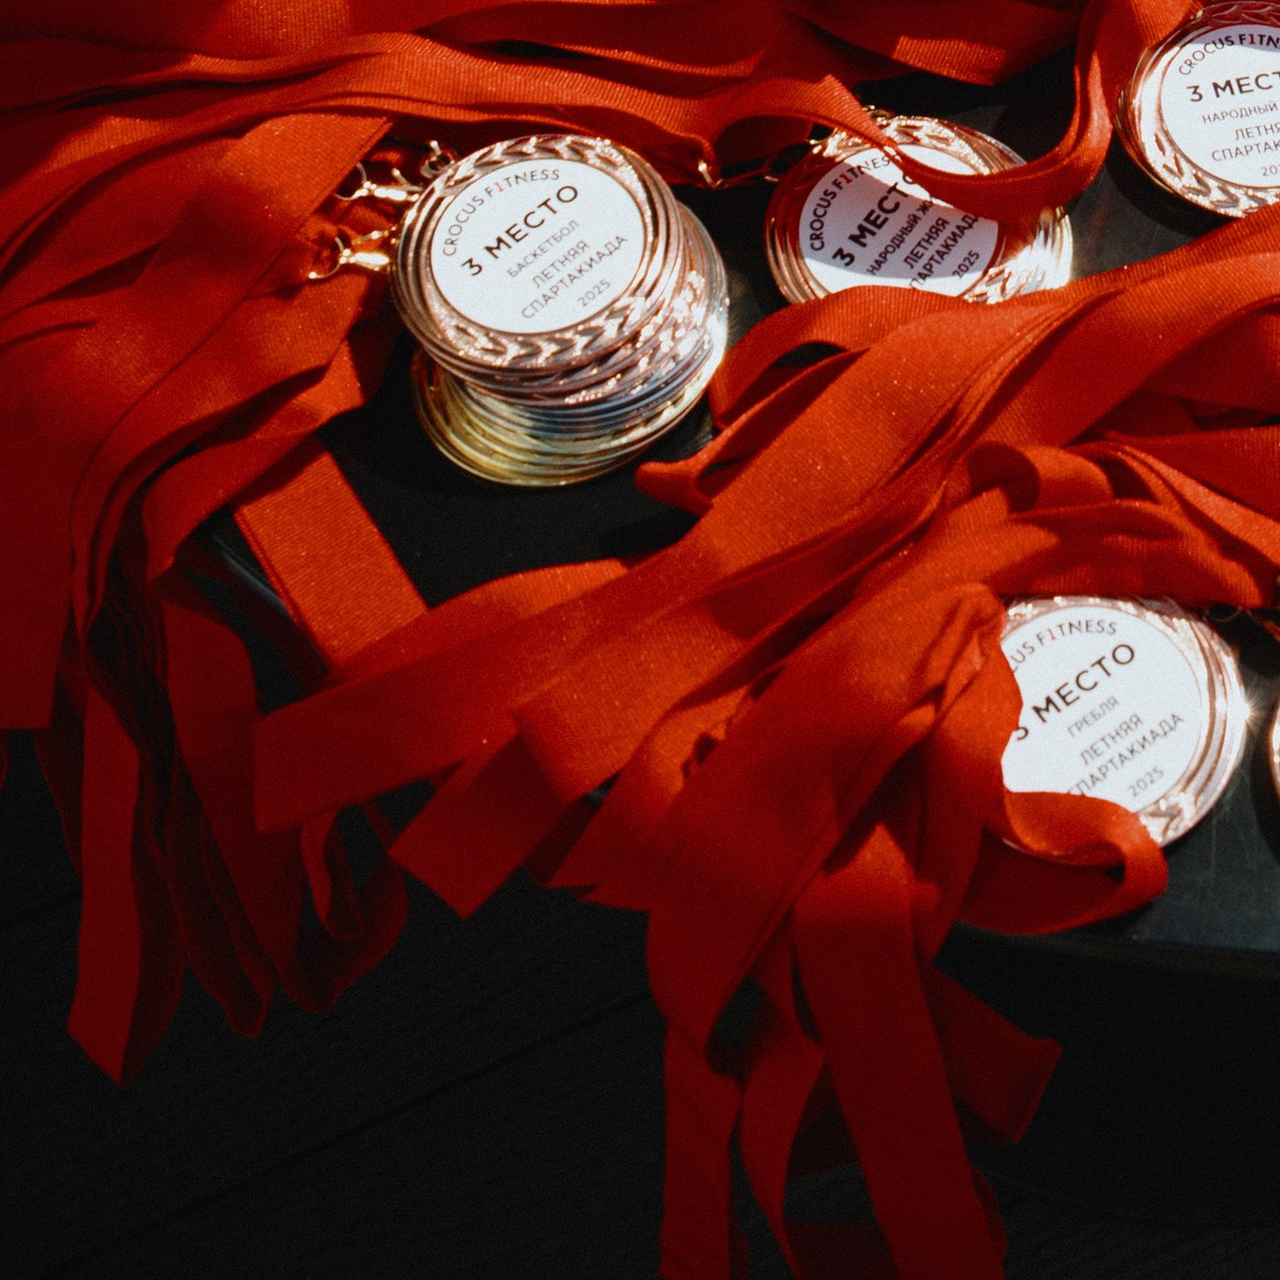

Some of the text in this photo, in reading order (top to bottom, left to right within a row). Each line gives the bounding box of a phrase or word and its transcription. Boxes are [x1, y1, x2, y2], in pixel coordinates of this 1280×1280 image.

[1178, 35, 1235, 75] CROCUS
[1187, 85, 1203, 102] 3
[1202, 101, 1278, 124] НАРОДНЫЙ
[443, 196, 484, 257] CROCUS
[461, 185, 578, 276] 3 МЕСТО
[810, 189, 838, 251] CROCUS
[866, 214, 921, 275] НАРОДНЫЙ
[903, 217, 950, 269] ЛЕТНЯЯ
[507, 220, 580, 278] БАСКЕТБОЛ
[532, 240, 590, 288] ЛЕТНЯЯ
[832, 248, 855, 267] 3
[952, 250, 980, 279] 2025
[522, 235, 628, 319] СПАРТАКИАДА
[1032, 644, 1135, 723] МЕСТО
[1067, 695, 1120, 737] ГРЕБЛЯ
[1080, 714, 1144, 766] ЛЕТНЯЯ
